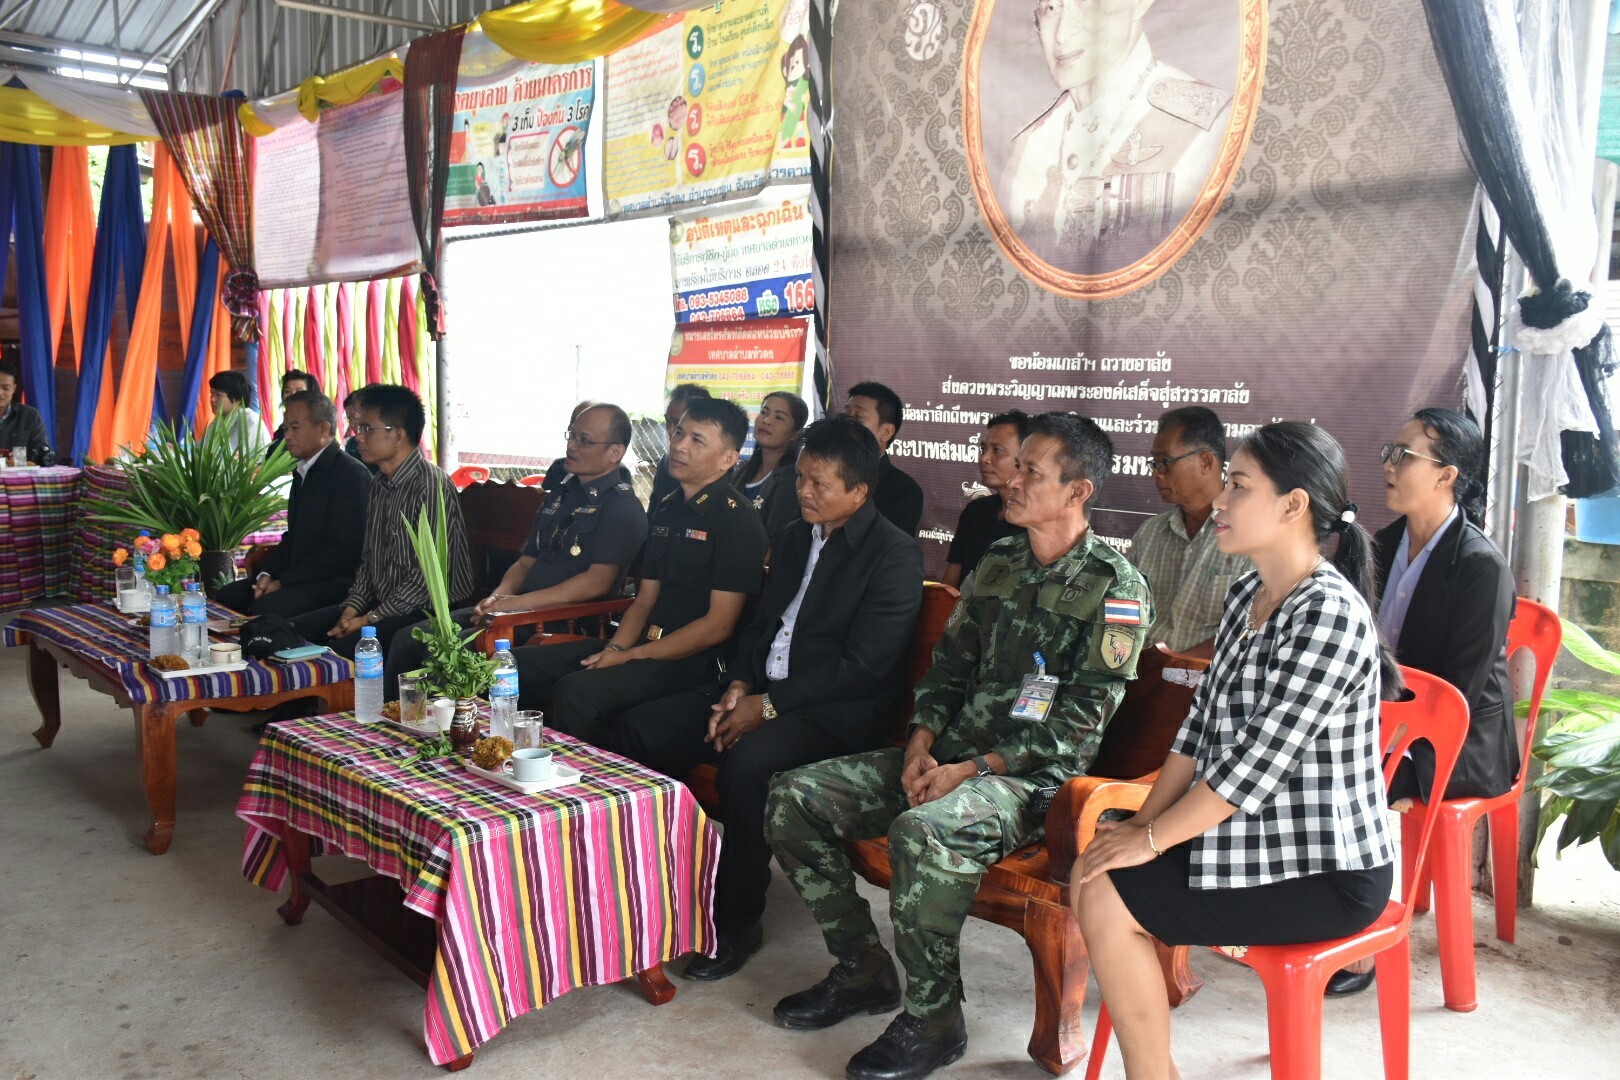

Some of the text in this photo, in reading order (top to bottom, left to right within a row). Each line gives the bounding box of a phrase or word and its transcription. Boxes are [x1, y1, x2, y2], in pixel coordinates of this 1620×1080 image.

[513, 67, 592, 103] ด้วยมาตรการ
[512, 116, 519, 132] 3
[520, 107, 535, 130] เก็บ
[537, 104, 565, 127] ป้องกัน
[567, 106, 574, 122] 3
[576, 99, 590, 121] โรค
[686, 200, 805, 249] อุบัติเหตุและฉุกเฉิน
[741, 233, 812, 256] เทศบาลตำบลหัวด
[689, 287, 749, 309] 093-5345088
[756, 290, 779, 316] หรือ
[784, 279, 814, 313] 166
[708, 345, 774, 360] เทศบาลตำบลหัวดง
[1009, 351, 1172, 372] ขอน้อมเกล้าฯ ถวายอาลัย
[901, 401, 992, 425] น้อมรำลึกถึงพร
